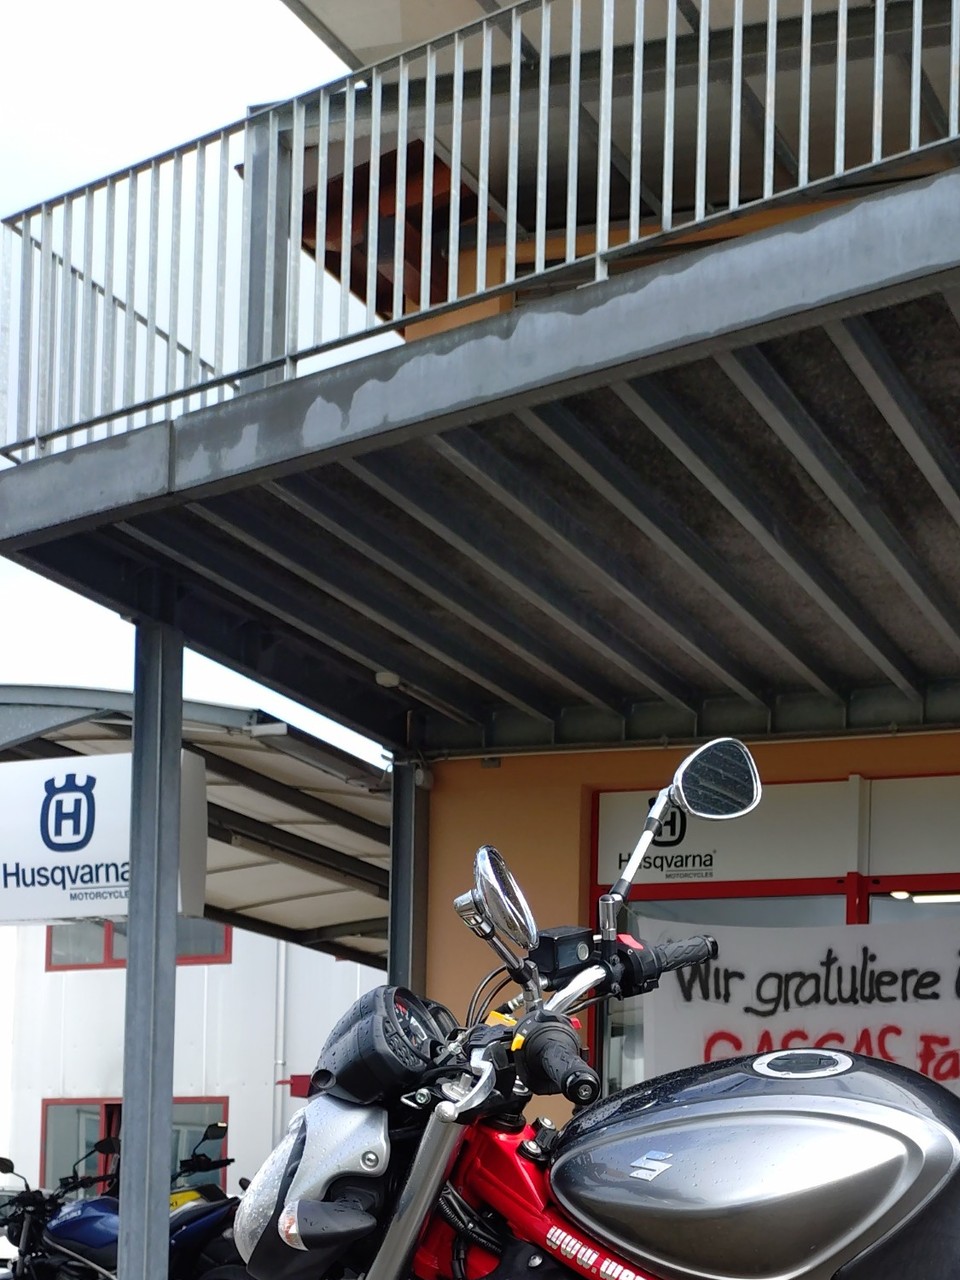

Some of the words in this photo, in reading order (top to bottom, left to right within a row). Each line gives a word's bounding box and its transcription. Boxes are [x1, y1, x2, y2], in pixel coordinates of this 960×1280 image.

[618, 852, 714, 872] Hsqvarna
[70, 890, 129, 901] MOTORCYCLE
[676, 958, 745, 1003] Wir
[743, 946, 941, 1018] gratuliere
